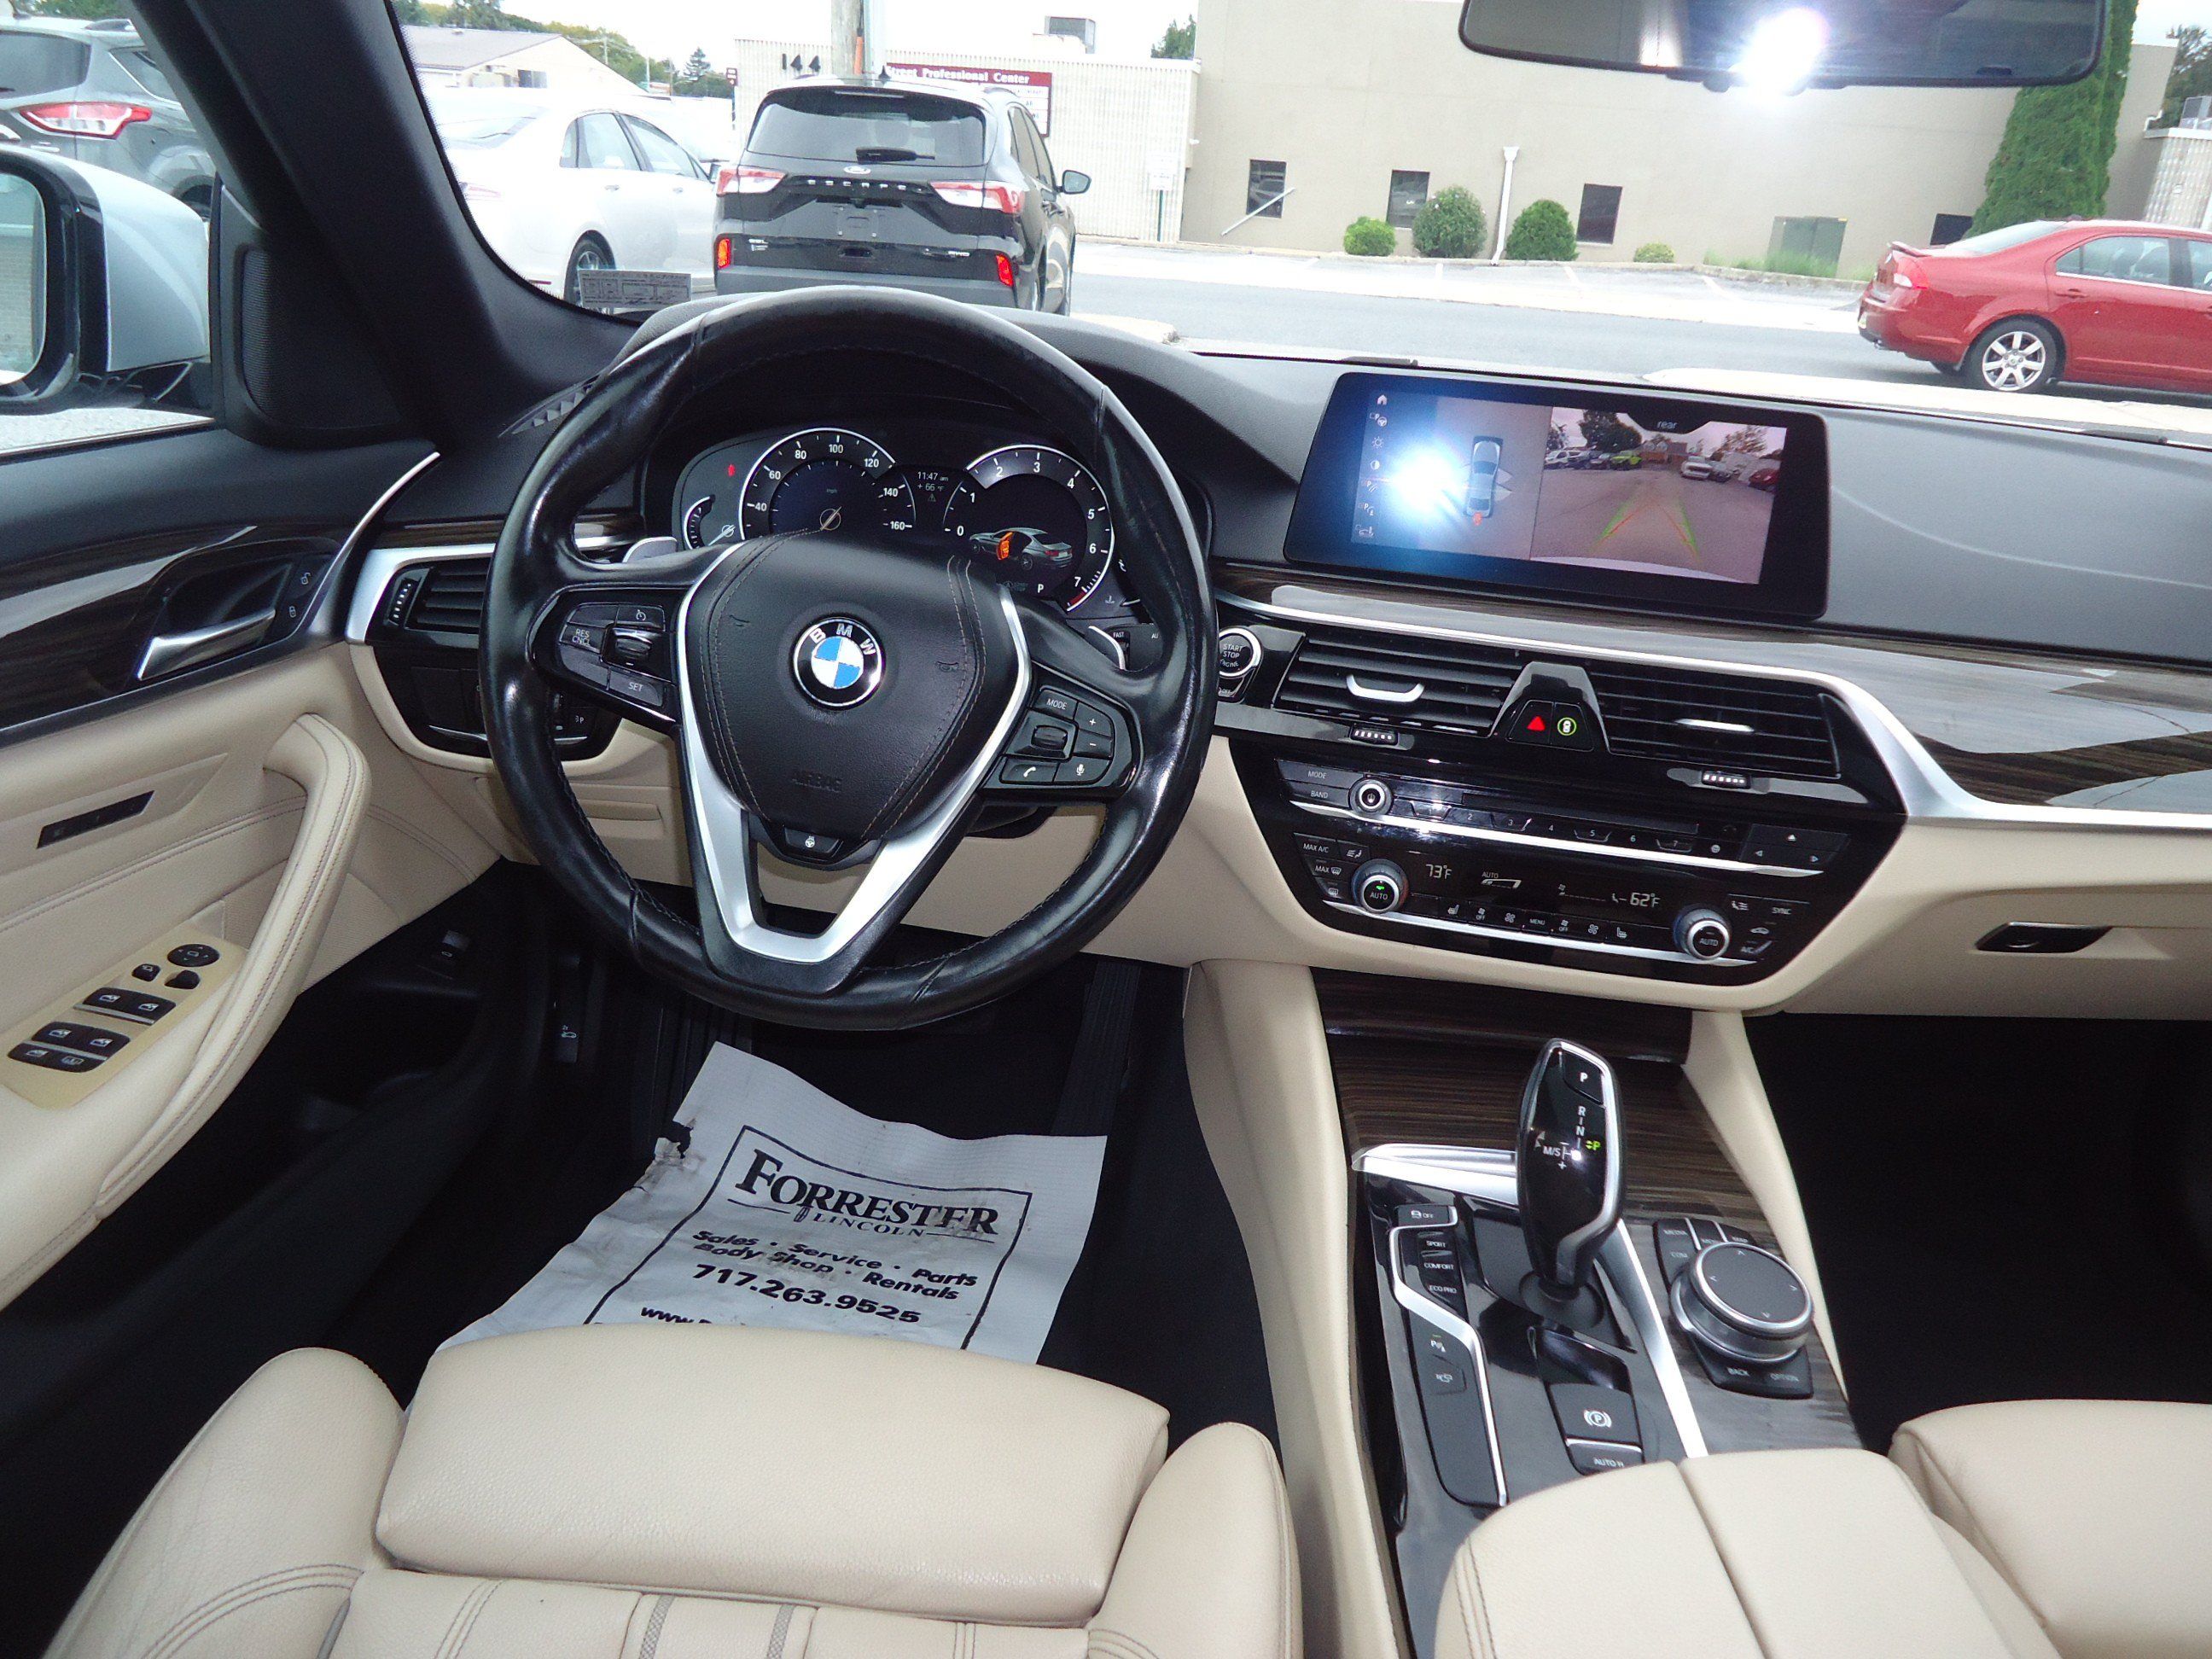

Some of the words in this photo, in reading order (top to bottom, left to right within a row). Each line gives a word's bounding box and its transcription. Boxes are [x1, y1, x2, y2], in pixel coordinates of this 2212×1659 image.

[922, 67, 988, 82] Professional
[993, 72, 1030, 84] Center
[829, 444, 844, 454] 100
[795, 450, 807, 460] 80
[864, 458, 880, 468] 120
[1033, 462, 1041, 473] 3
[769, 470, 781, 480] 60
[917, 471, 939, 480] 11:47
[996, 466, 1004, 478] 2
[1067, 478, 1074, 489] 4
[883, 488, 899, 498] 140
[969, 492, 975, 503] 1
[754, 503, 767, 512] 40
[1087, 509, 1095, 520] 5
[890, 521, 905, 530] 160
[957, 526, 964, 537] 0
[1089, 543, 1097, 554] 6
[1074, 576, 1081, 587] 7
[1037, 584, 1044, 593] P
[575, 628, 591, 638] RES
[572, 635, 591, 646] CNCL
[809, 623, 876, 655] BMW
[1222, 643, 1243, 651] START
[627, 683, 643, 692] SET
[1046, 698, 1068, 710] MODE
[1307, 770, 1327, 779] MODE
[1310, 790, 1329, 799] BAND
[1302, 843, 1317, 852] MAX
[1318, 845, 1330, 853] A/C
[1314, 865, 1330, 874] MAX
[1772, 906, 1792, 915] SYNC
[1529, 917, 1545, 926] MENU
[1699, 938, 1719, 946] AUTO
[1580, 1072, 1588, 1083] P
[1578, 1105, 1586, 1116] R
[1576, 1126, 1585, 1137] N
[1542, 1146, 1561, 1157] M/S
[735, 1148, 999, 1235] FORRESTER
[812, 1212, 925, 1237] LINCOLN
[692, 1231, 760, 1246] Sales
[788, 1243, 882, 1269] Service
[911, 1268, 978, 1286] Parts
[693, 1243, 764, 1260] Body
[770, 1251, 834, 1273] Shop
[862, 1271, 960, 1300] Rentals
[692, 1264, 922, 1323] 717.263.9525
[1593, 1458, 1616, 1467] AUTO
